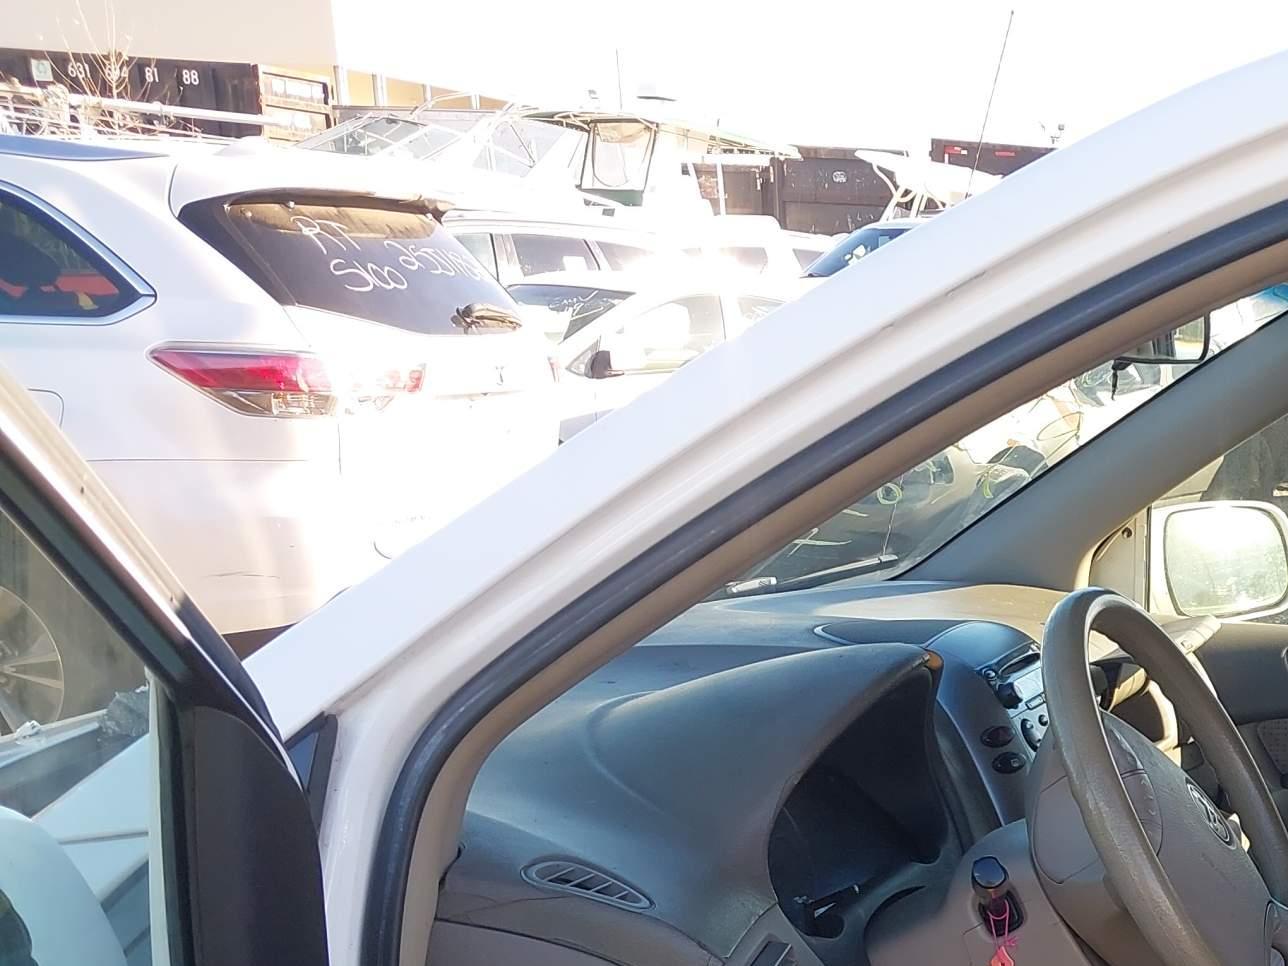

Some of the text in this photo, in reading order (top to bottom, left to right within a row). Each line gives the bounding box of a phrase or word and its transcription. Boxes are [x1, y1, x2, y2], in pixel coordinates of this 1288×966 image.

[145, 67, 160, 83] 81
[182, 69, 200, 86] 88
[290, 215, 362, 256] RT
